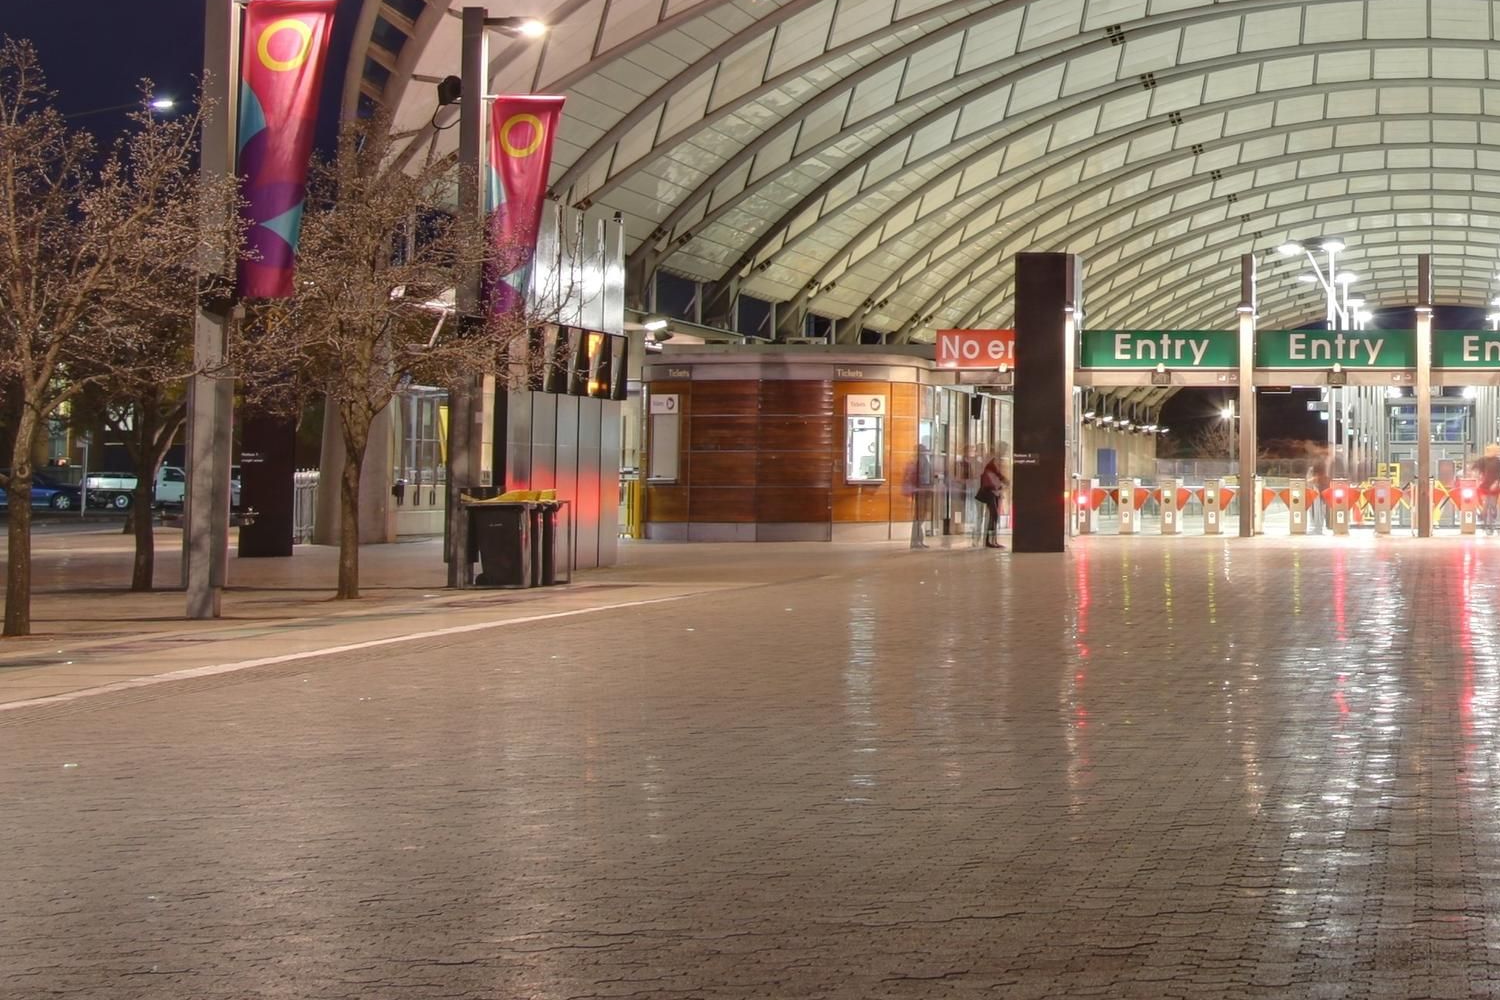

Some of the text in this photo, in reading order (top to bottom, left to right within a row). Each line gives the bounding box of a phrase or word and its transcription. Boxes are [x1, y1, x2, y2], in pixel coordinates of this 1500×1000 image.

[941, 335, 980, 360] No
[1114, 333, 1209, 366] Entry
[1289, 333, 1384, 365] Entry
[668, 368, 690, 377] Tickets
[836, 368, 863, 377] Tickets
